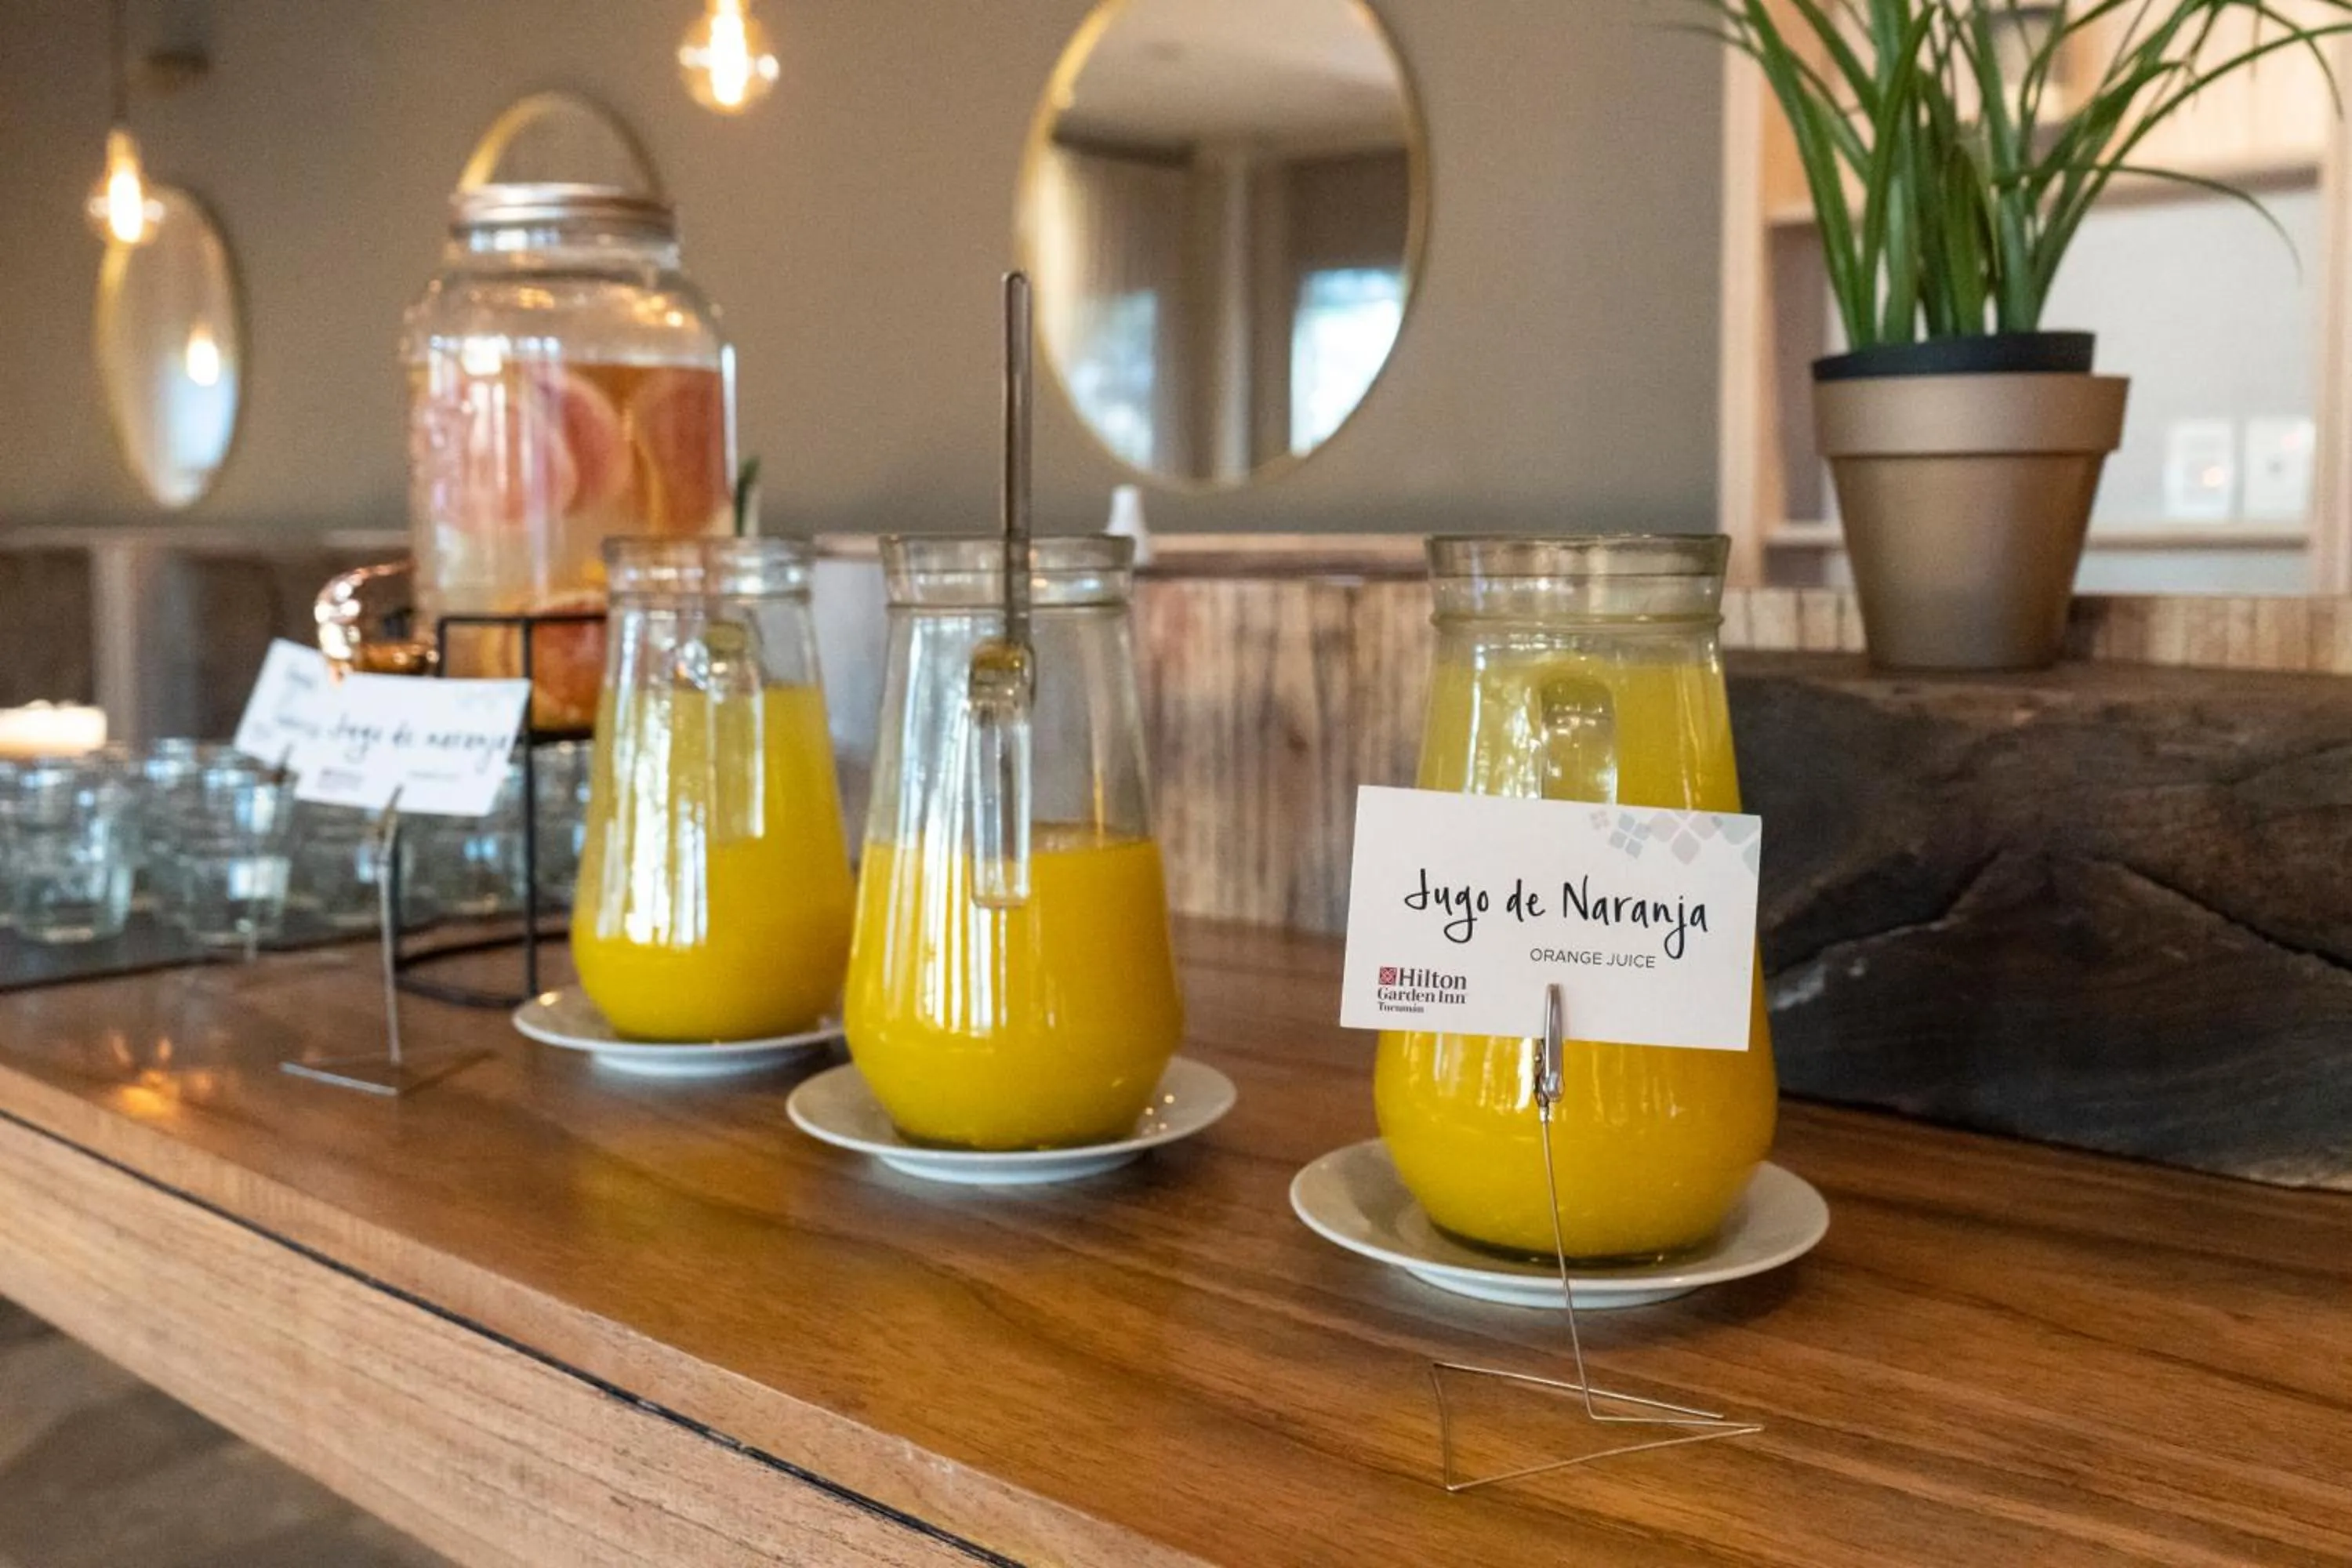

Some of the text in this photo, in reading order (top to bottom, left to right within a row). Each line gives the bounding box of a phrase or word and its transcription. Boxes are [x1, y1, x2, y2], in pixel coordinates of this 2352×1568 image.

[1403, 868, 1709, 960] Jugo de Naranja
[1530, 948, 1657, 969] ORANGE JUICE
[1399, 967, 1467, 990] Hilton
[1377, 987, 1467, 1004] Garden Inn
